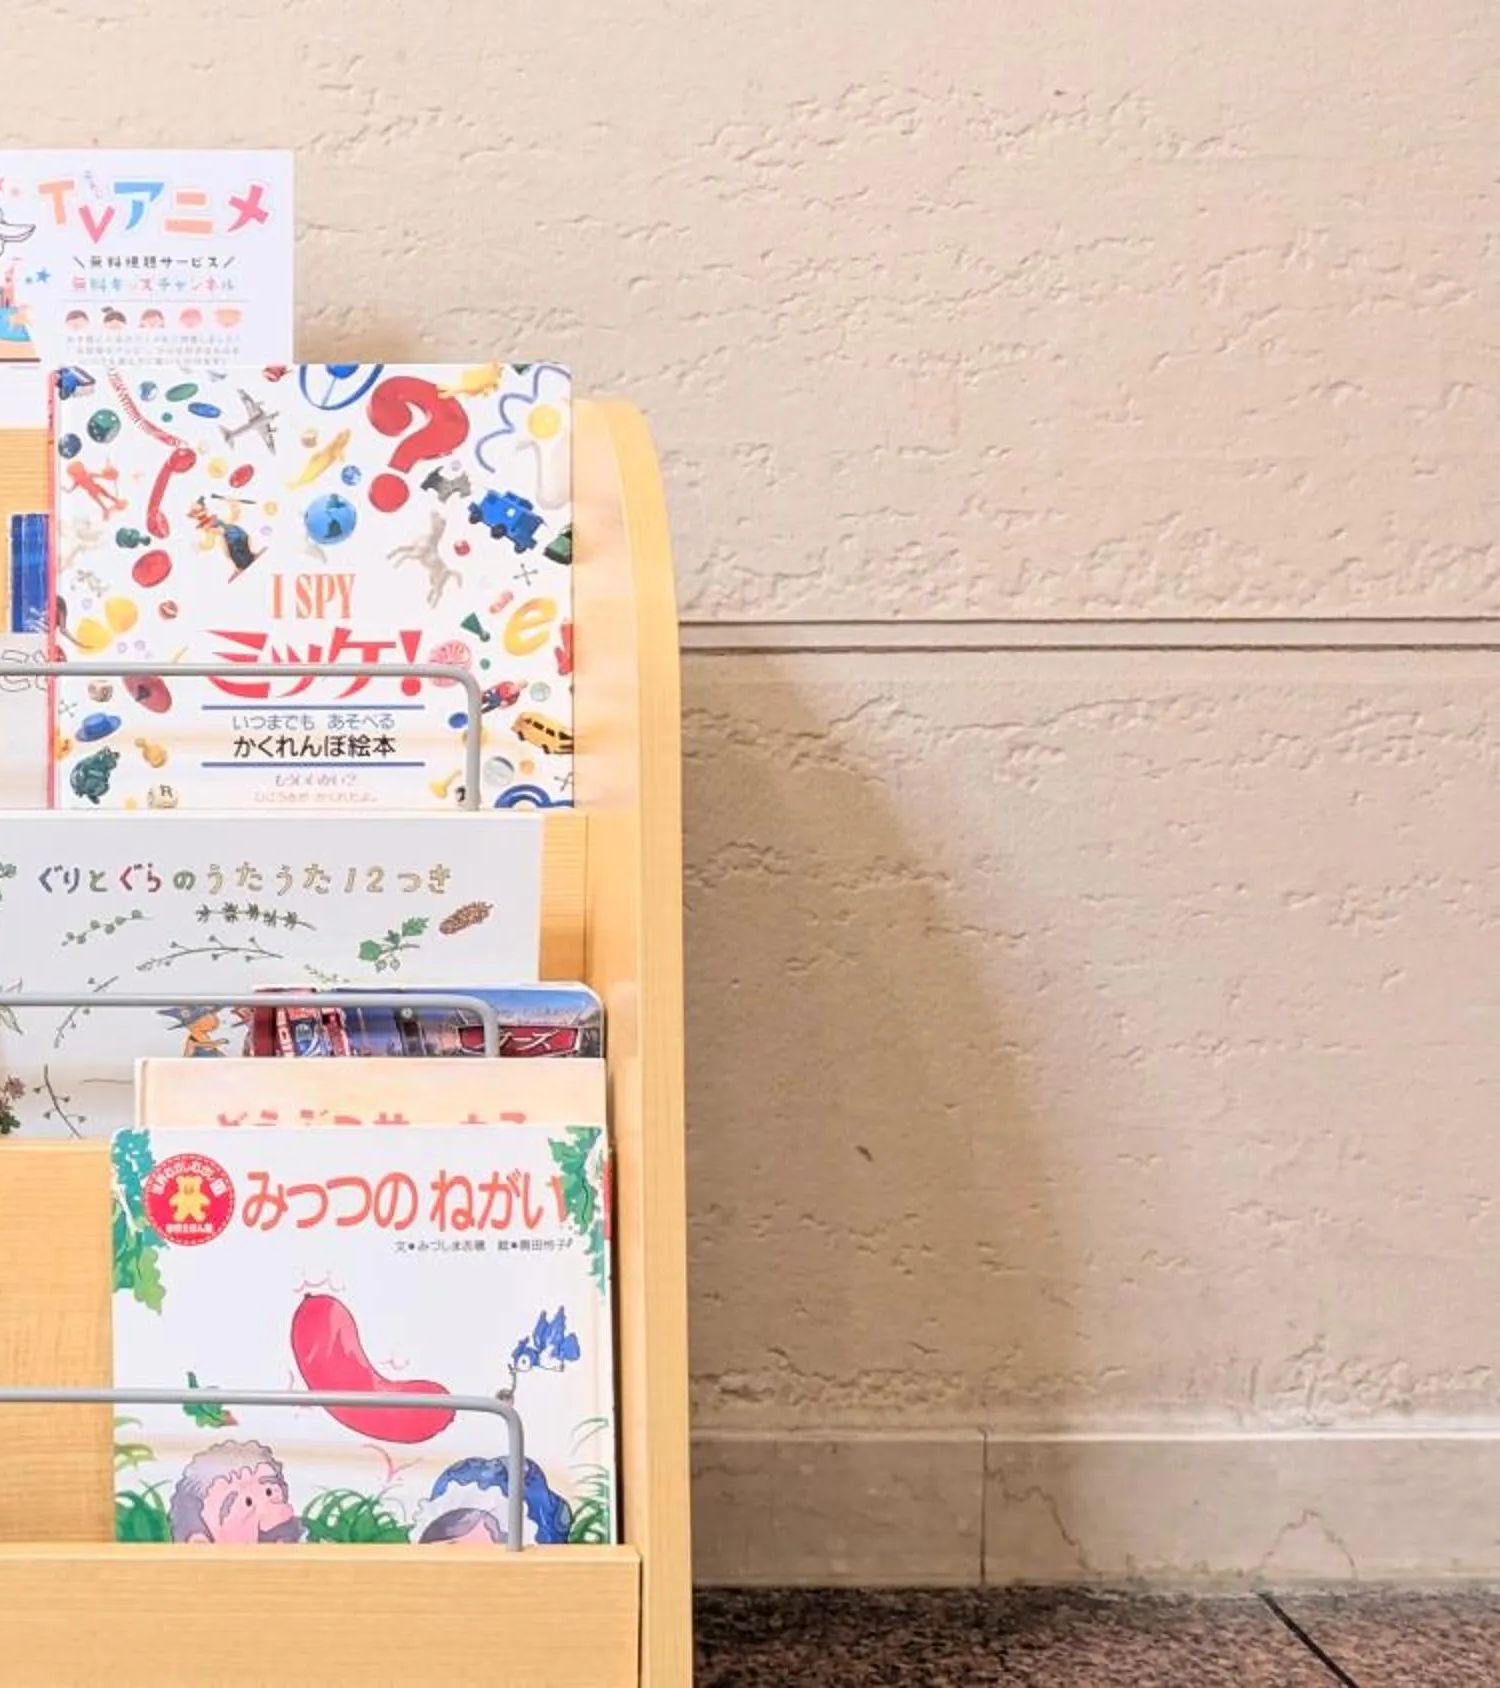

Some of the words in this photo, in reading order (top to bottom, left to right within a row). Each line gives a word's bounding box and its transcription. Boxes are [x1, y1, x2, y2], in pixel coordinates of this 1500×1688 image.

[38, 174, 269, 245] TVアニメ
[272, 574, 284, 619] I
[295, 574, 356, 619] SPY
[232, 713, 316, 731] いつまでも
[327, 713, 396, 731] あそべる
[232, 733, 397, 758] かくれんぼ絵本
[38, 860, 453, 895] ぐりとぐらのうたうた12つき
[430, 1168, 567, 1232] ねがい
